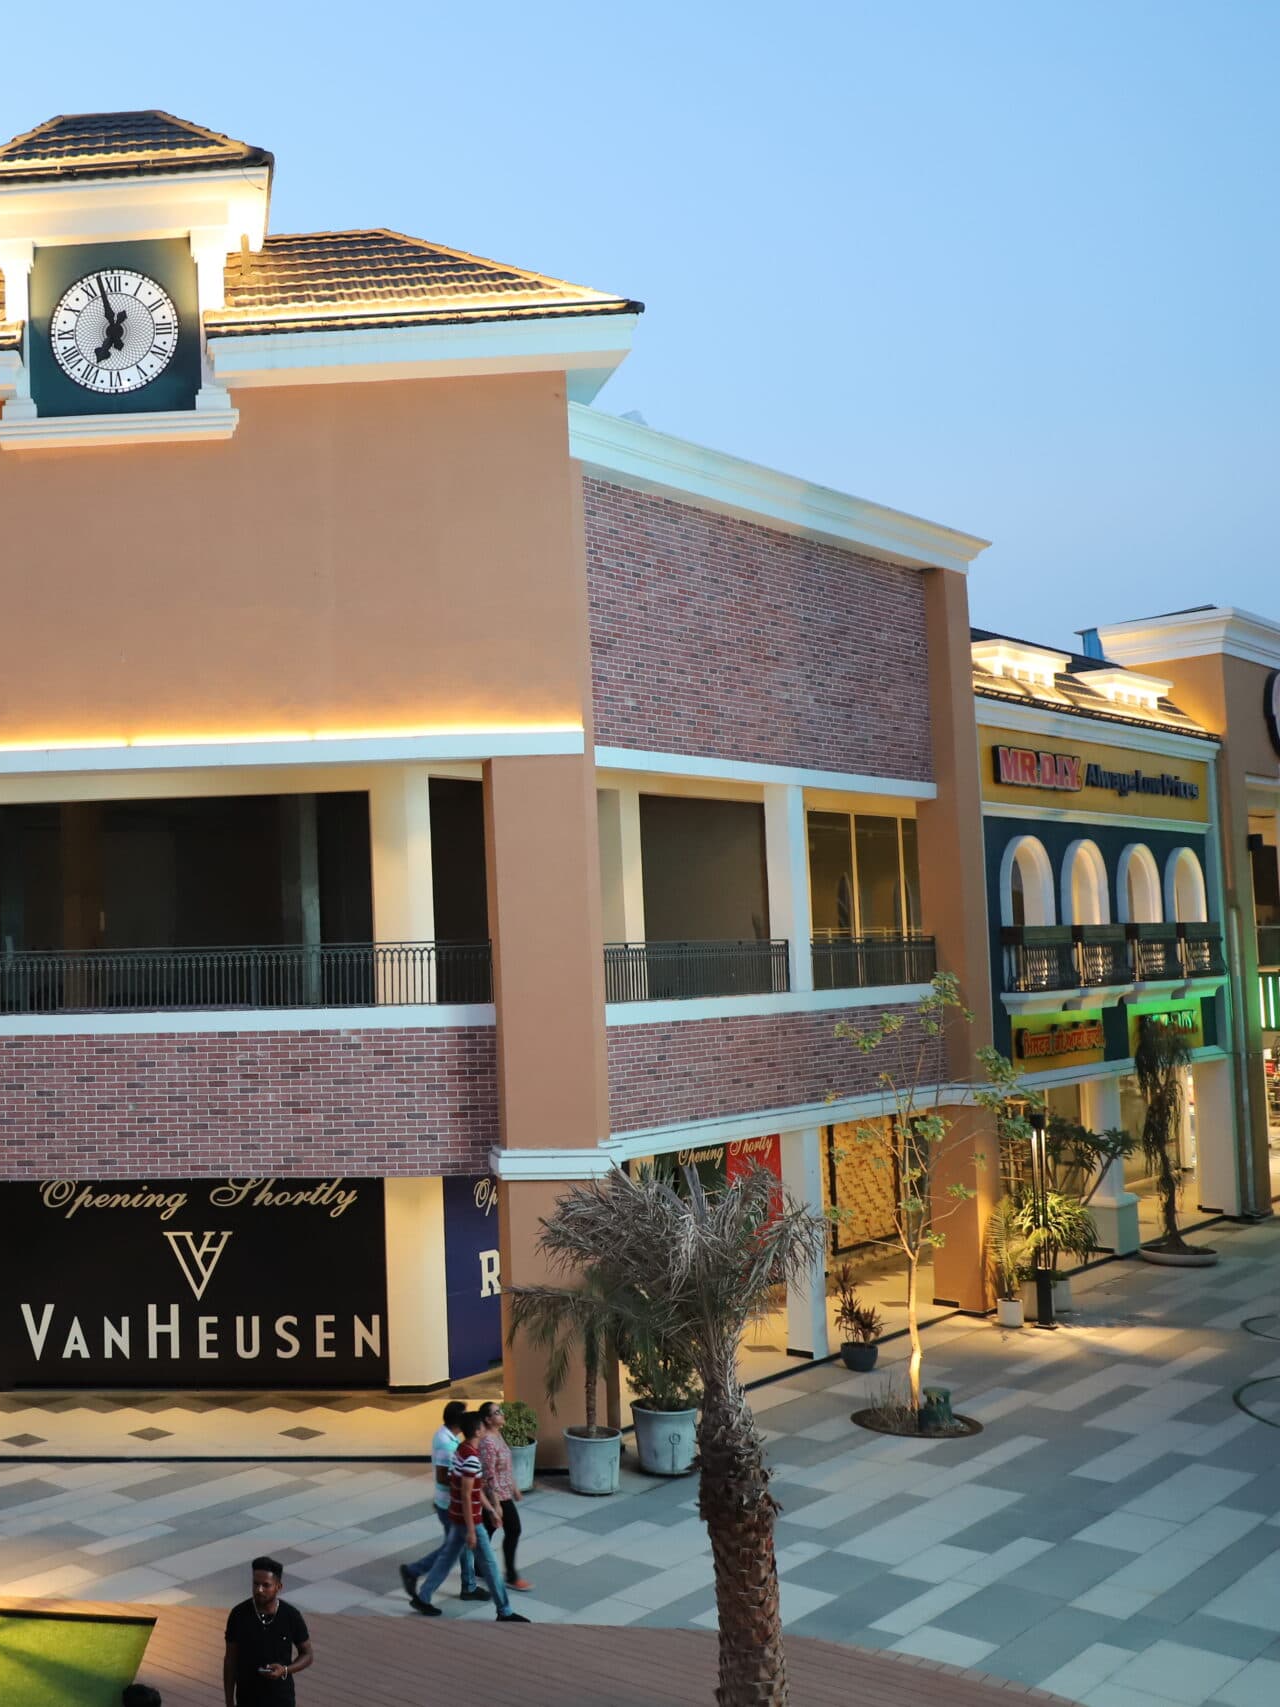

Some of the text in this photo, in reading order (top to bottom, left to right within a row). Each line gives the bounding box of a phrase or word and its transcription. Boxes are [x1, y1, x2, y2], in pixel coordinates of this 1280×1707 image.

[105, 275, 121, 293] XII
[39, 1177, 358, 1221] Opening Shortly
